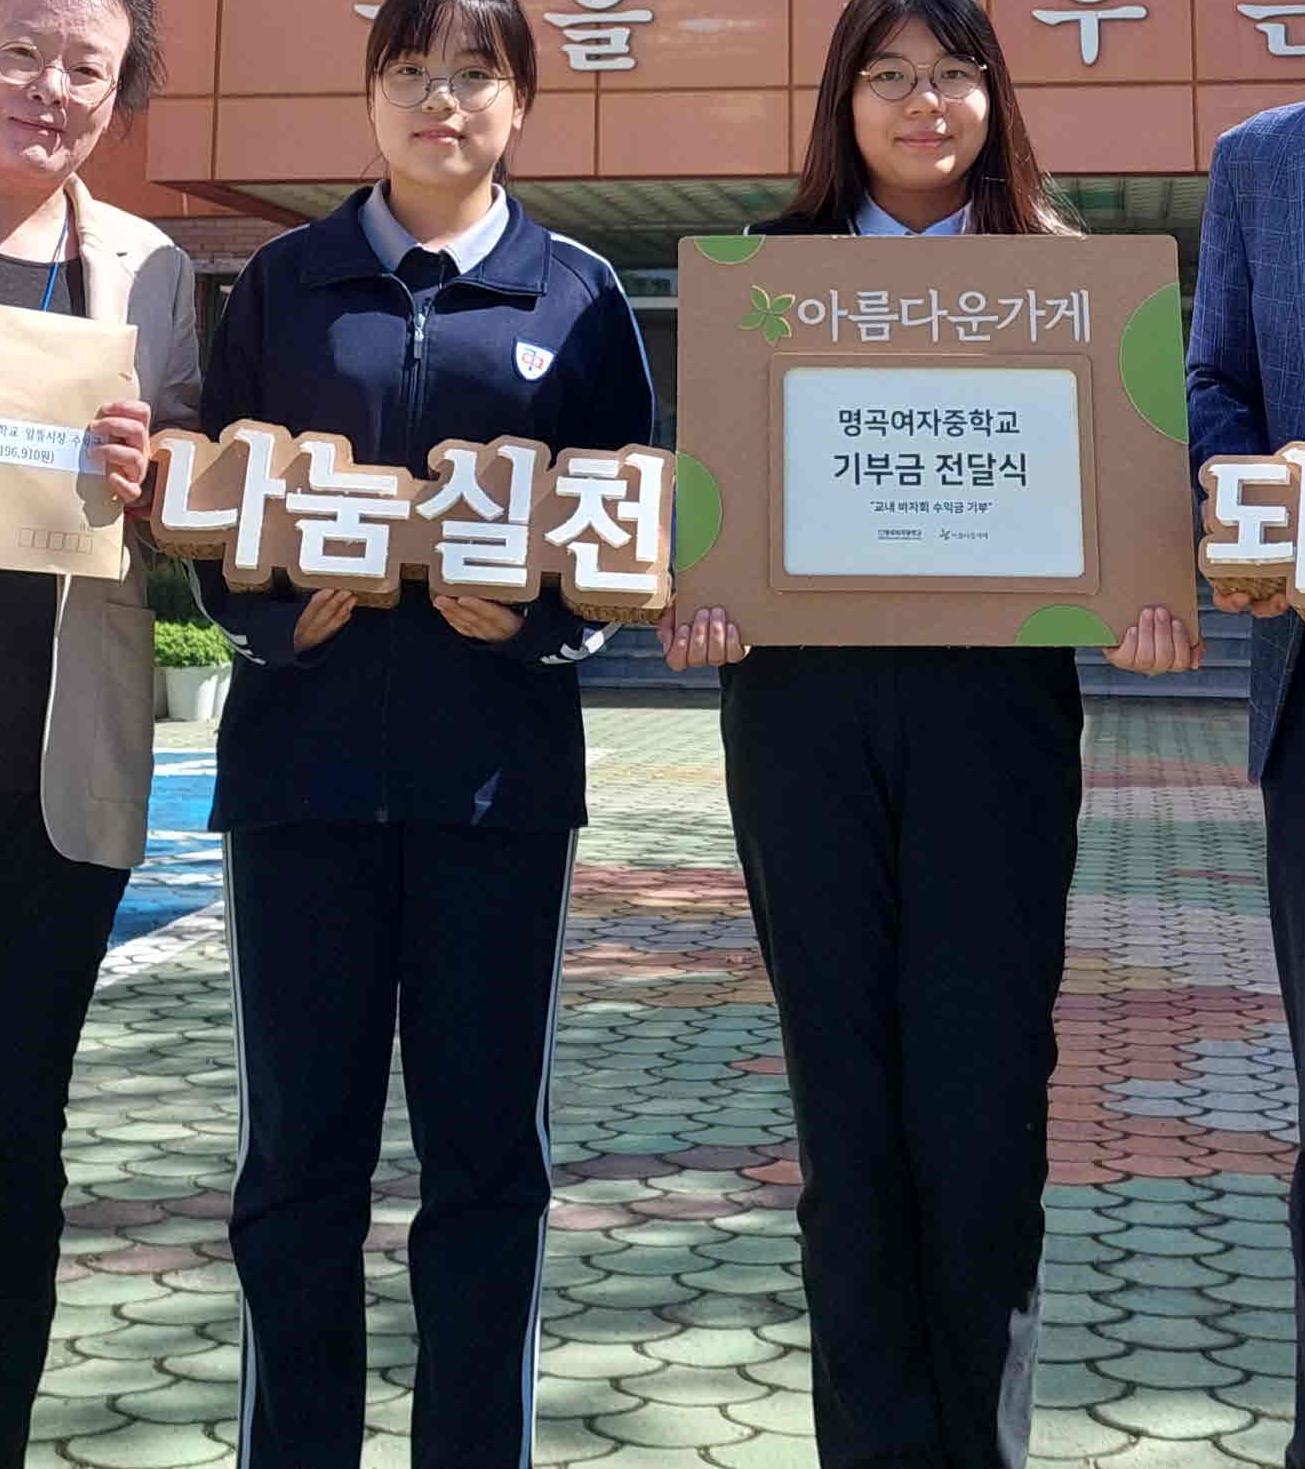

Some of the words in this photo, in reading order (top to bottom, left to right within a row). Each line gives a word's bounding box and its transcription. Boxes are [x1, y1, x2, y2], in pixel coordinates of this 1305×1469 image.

[797, 288, 1092, 343] 아름다운가게
[839, 408, 1021, 438] 명곡여자중학교
[833, 452, 925, 486] 기부금
[935, 452, 1027, 487] 전달식
[158, 427, 666, 594] 나눔실천
